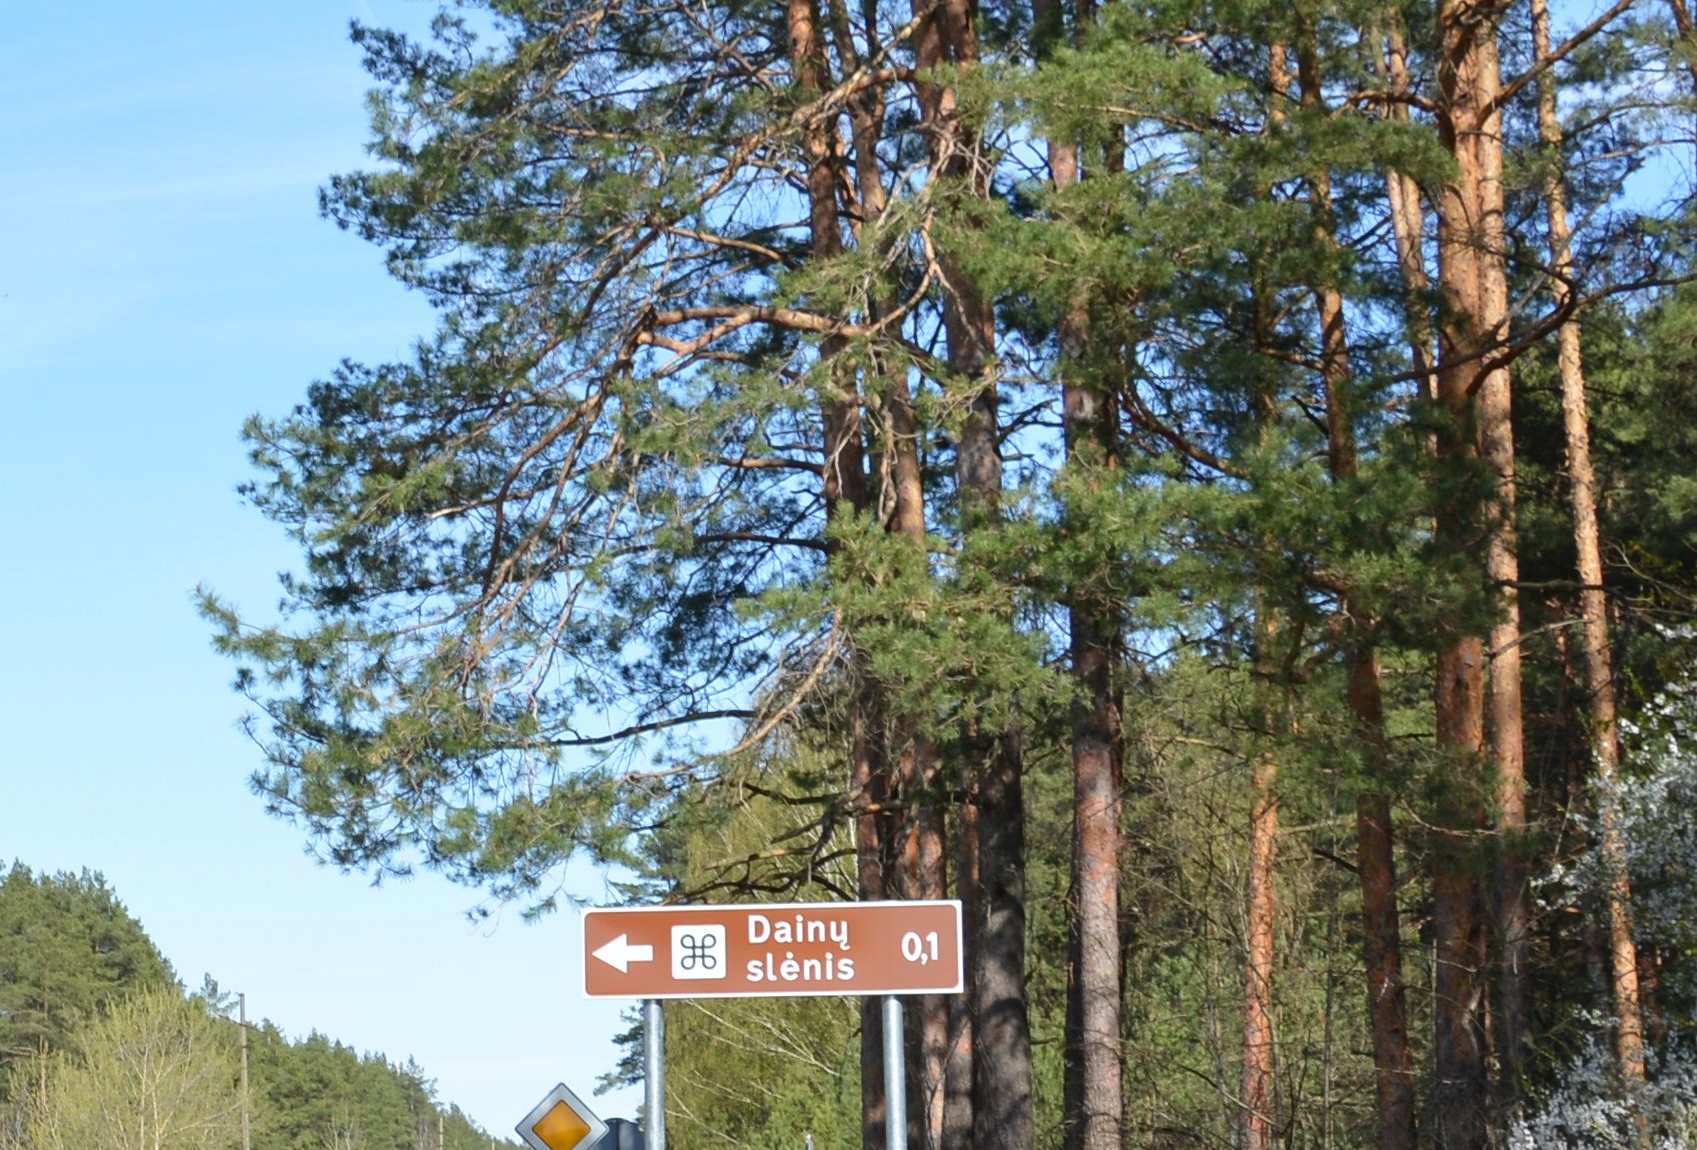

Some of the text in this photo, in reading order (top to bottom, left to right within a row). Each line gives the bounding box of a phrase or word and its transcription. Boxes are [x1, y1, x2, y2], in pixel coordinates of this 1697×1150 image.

[747, 914, 851, 951] Dainų
[901, 931, 939, 966] 0,1
[746, 951, 855, 982] slėnis
